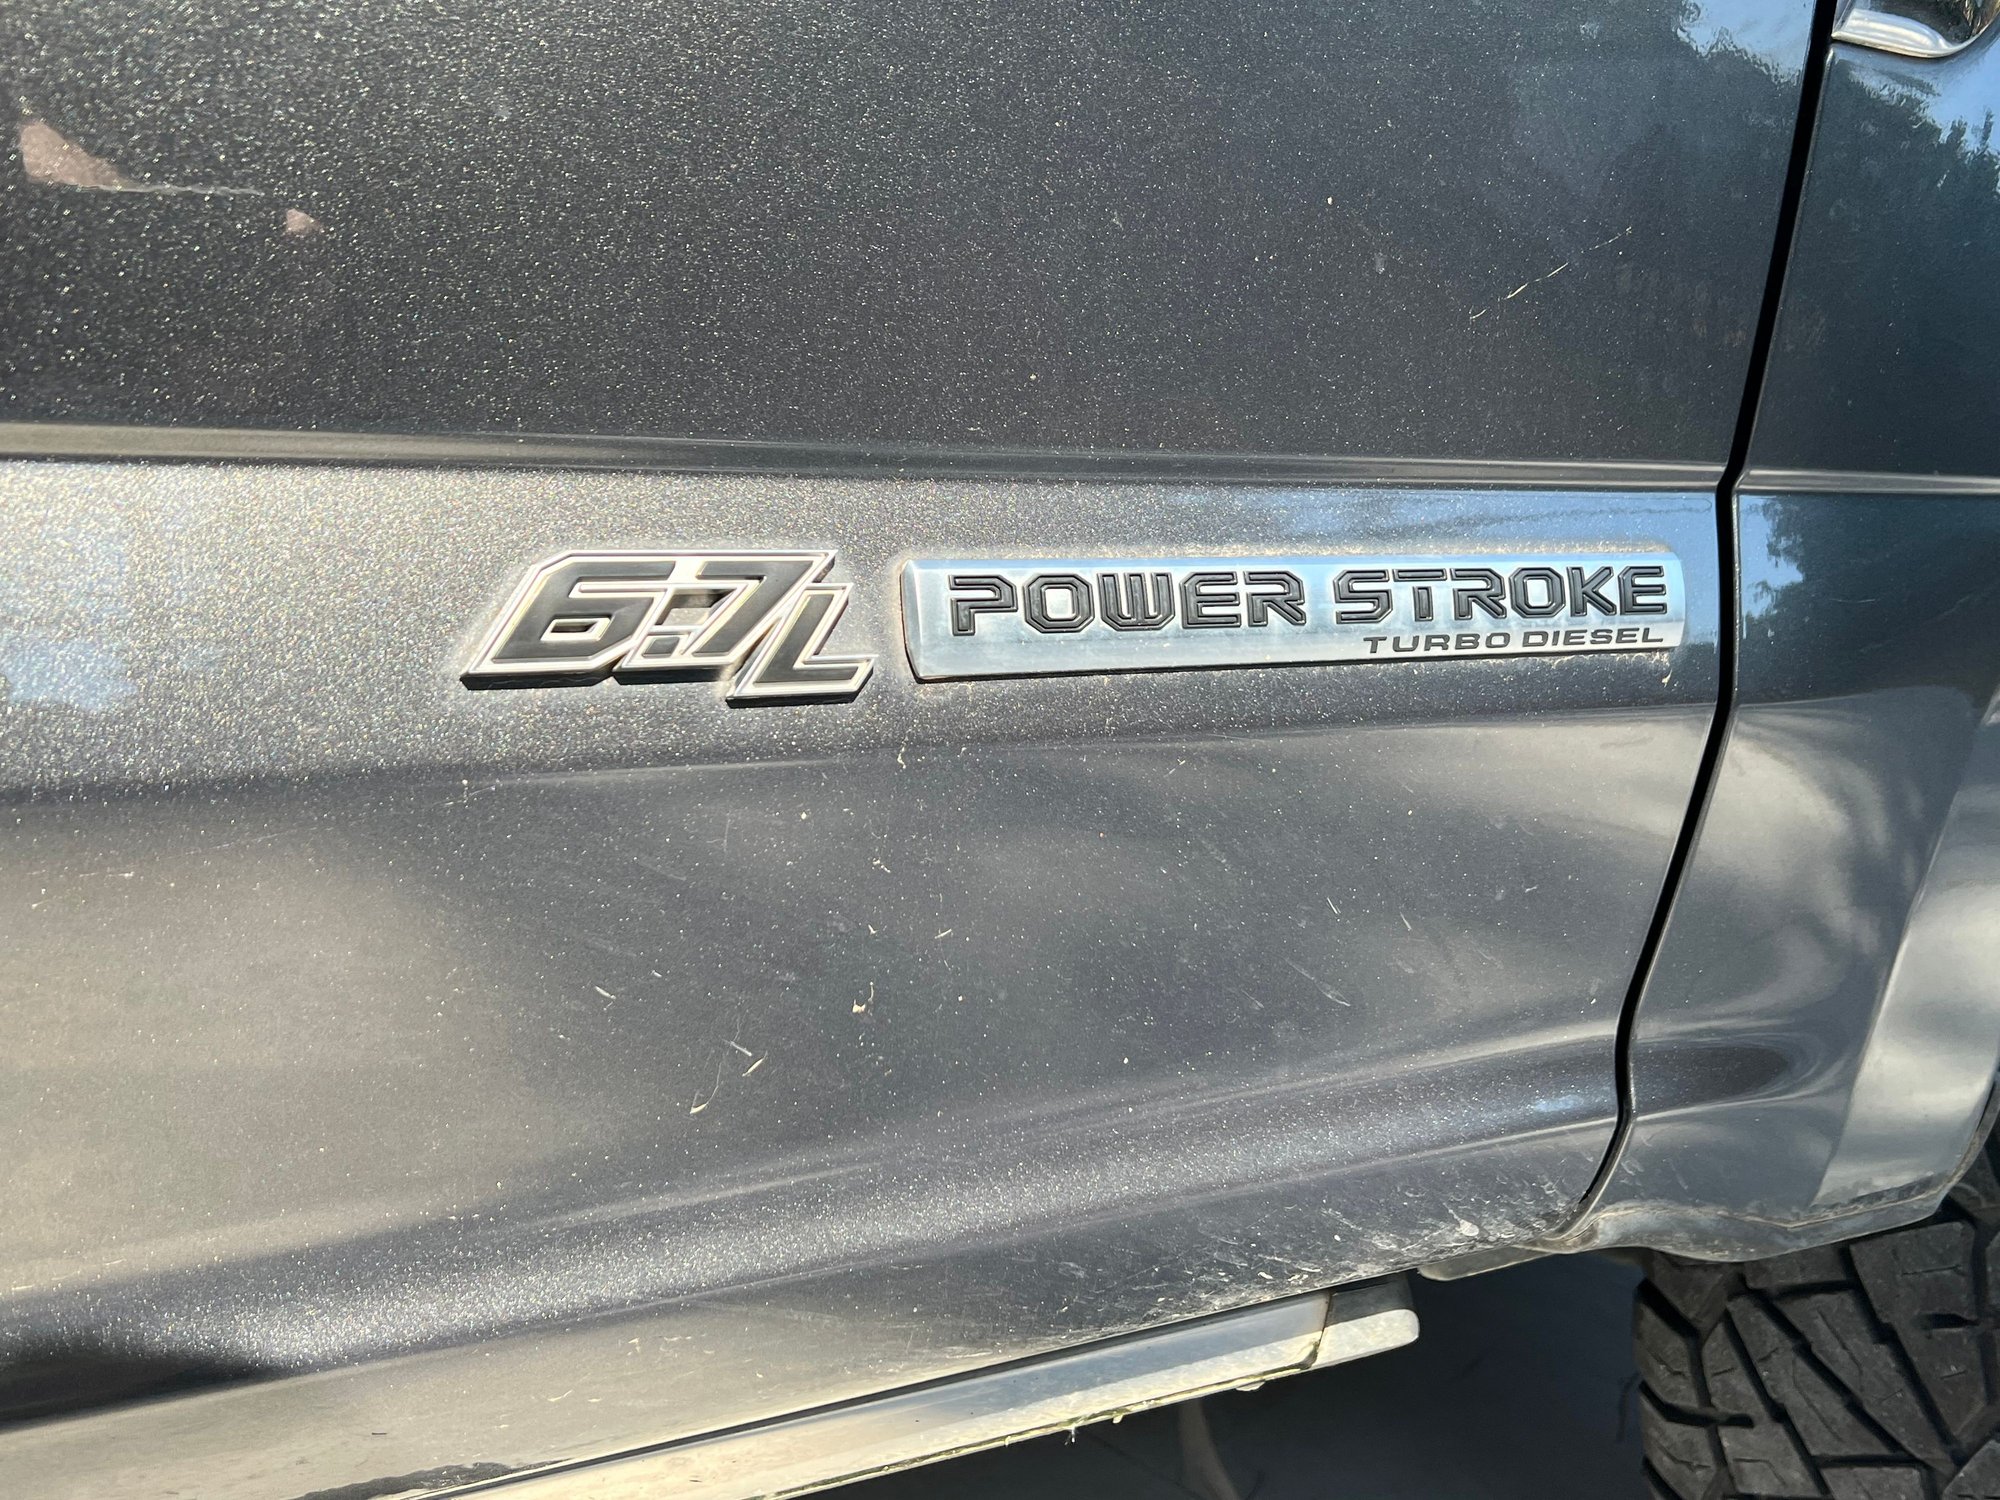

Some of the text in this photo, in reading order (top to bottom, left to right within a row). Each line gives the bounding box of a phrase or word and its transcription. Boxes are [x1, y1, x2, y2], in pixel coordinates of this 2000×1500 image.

[463, 551, 878, 704] 6.7L
[949, 565, 1668, 637] POWER STROKE
[1362, 627, 1665, 654] TURBO DIESEL
